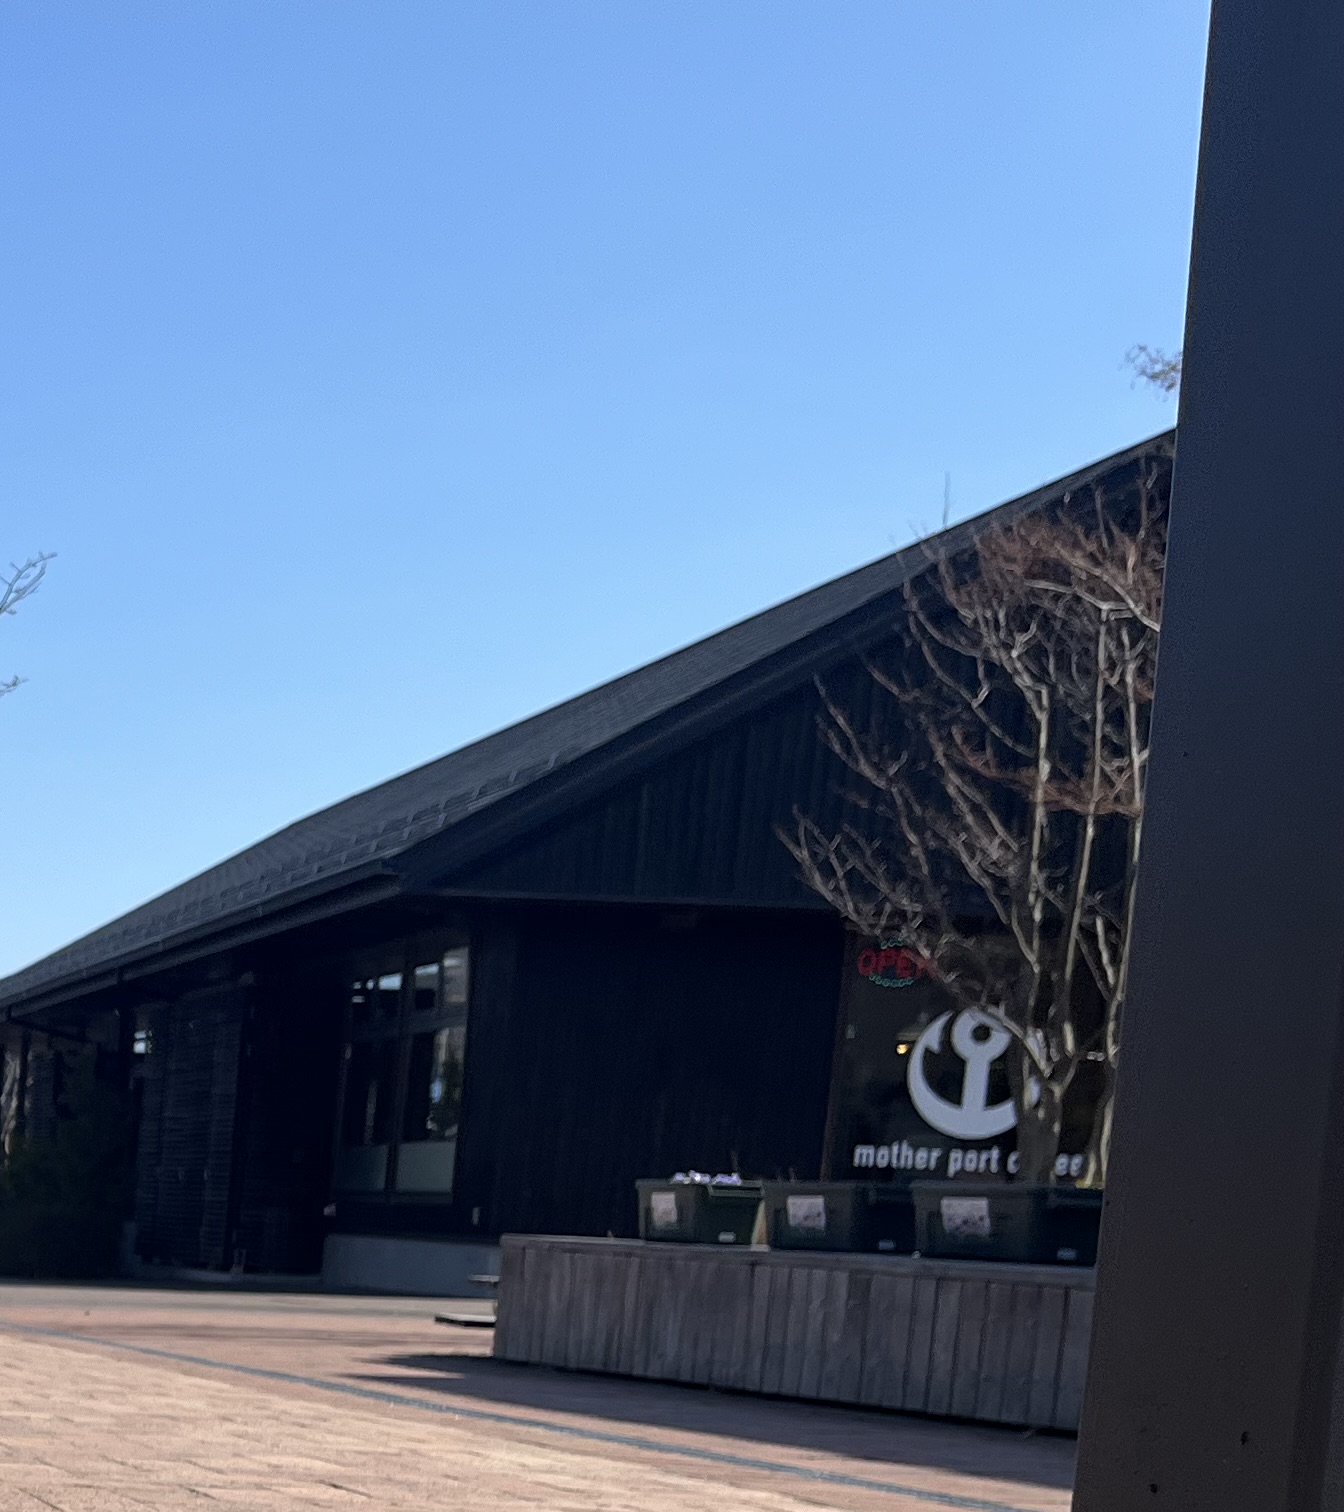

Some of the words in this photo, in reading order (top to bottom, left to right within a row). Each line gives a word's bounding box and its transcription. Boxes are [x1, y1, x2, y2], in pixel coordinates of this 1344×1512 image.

[853, 1140, 942, 1171] mother
[947, 1145, 1000, 1178] port
[1007, 1151, 1084, 1177] cee
